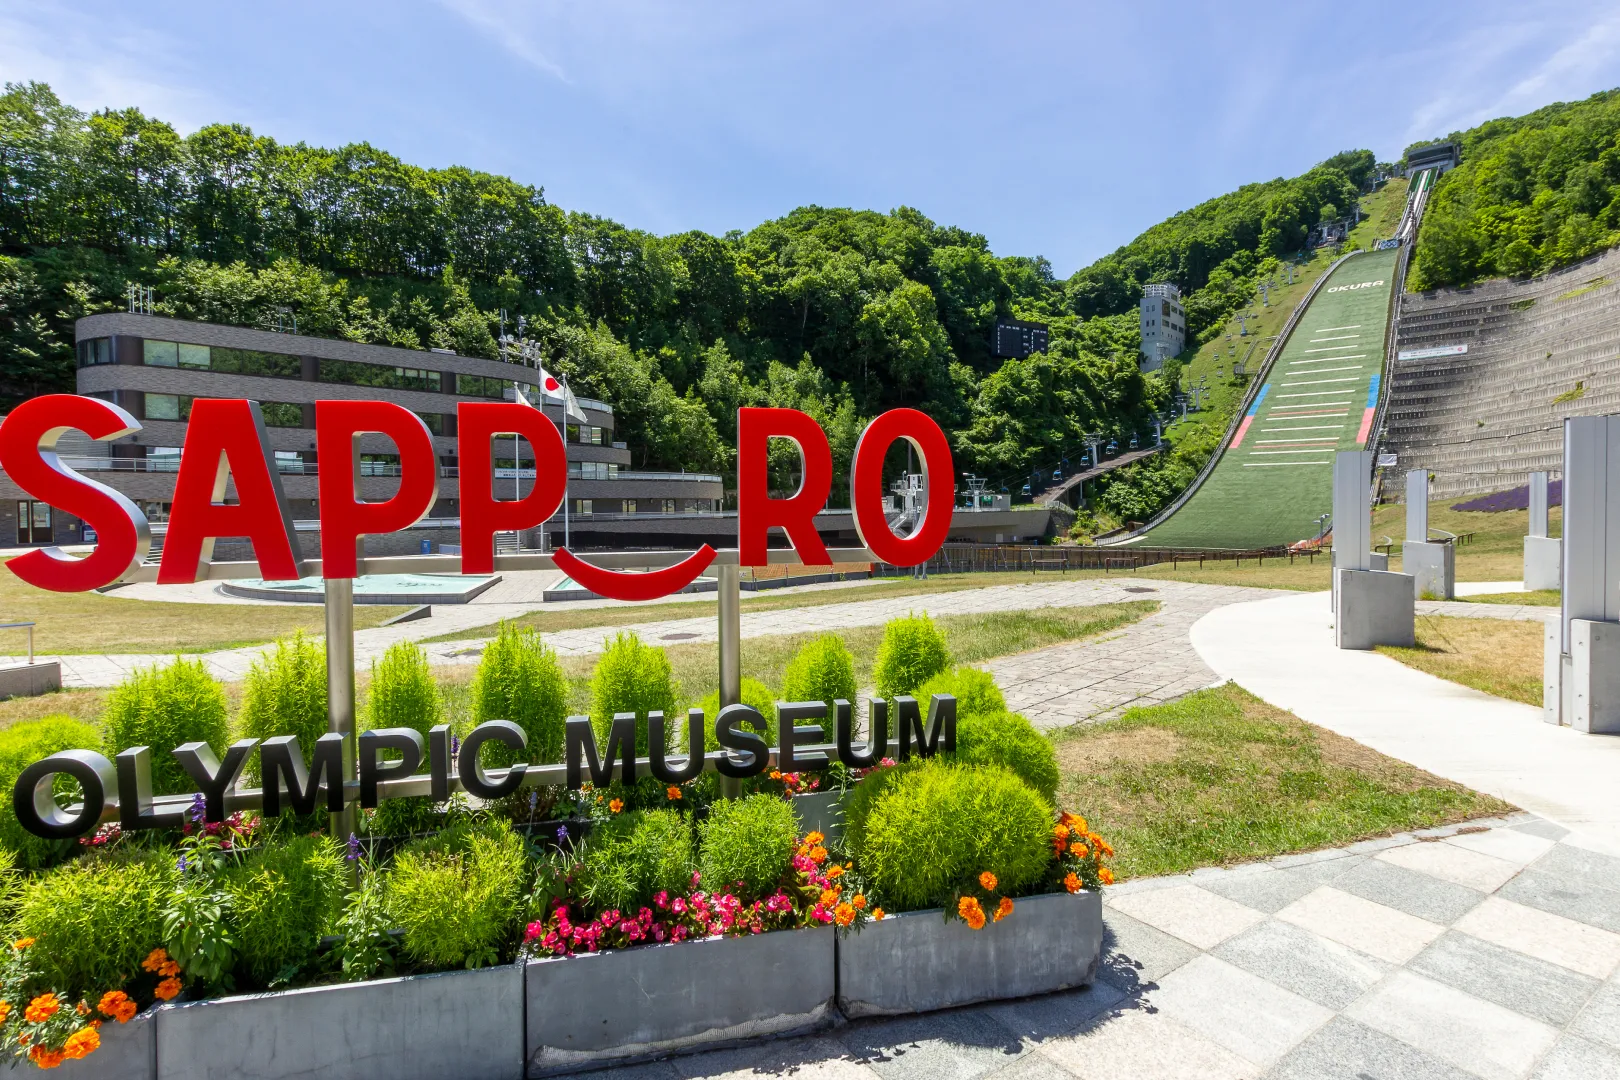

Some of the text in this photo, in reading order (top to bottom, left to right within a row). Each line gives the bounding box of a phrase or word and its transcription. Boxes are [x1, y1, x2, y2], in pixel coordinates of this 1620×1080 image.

[1327, 280, 1385, 293] OKURA
[13, 694, 956, 840] OLYMPIC MUSEUM
